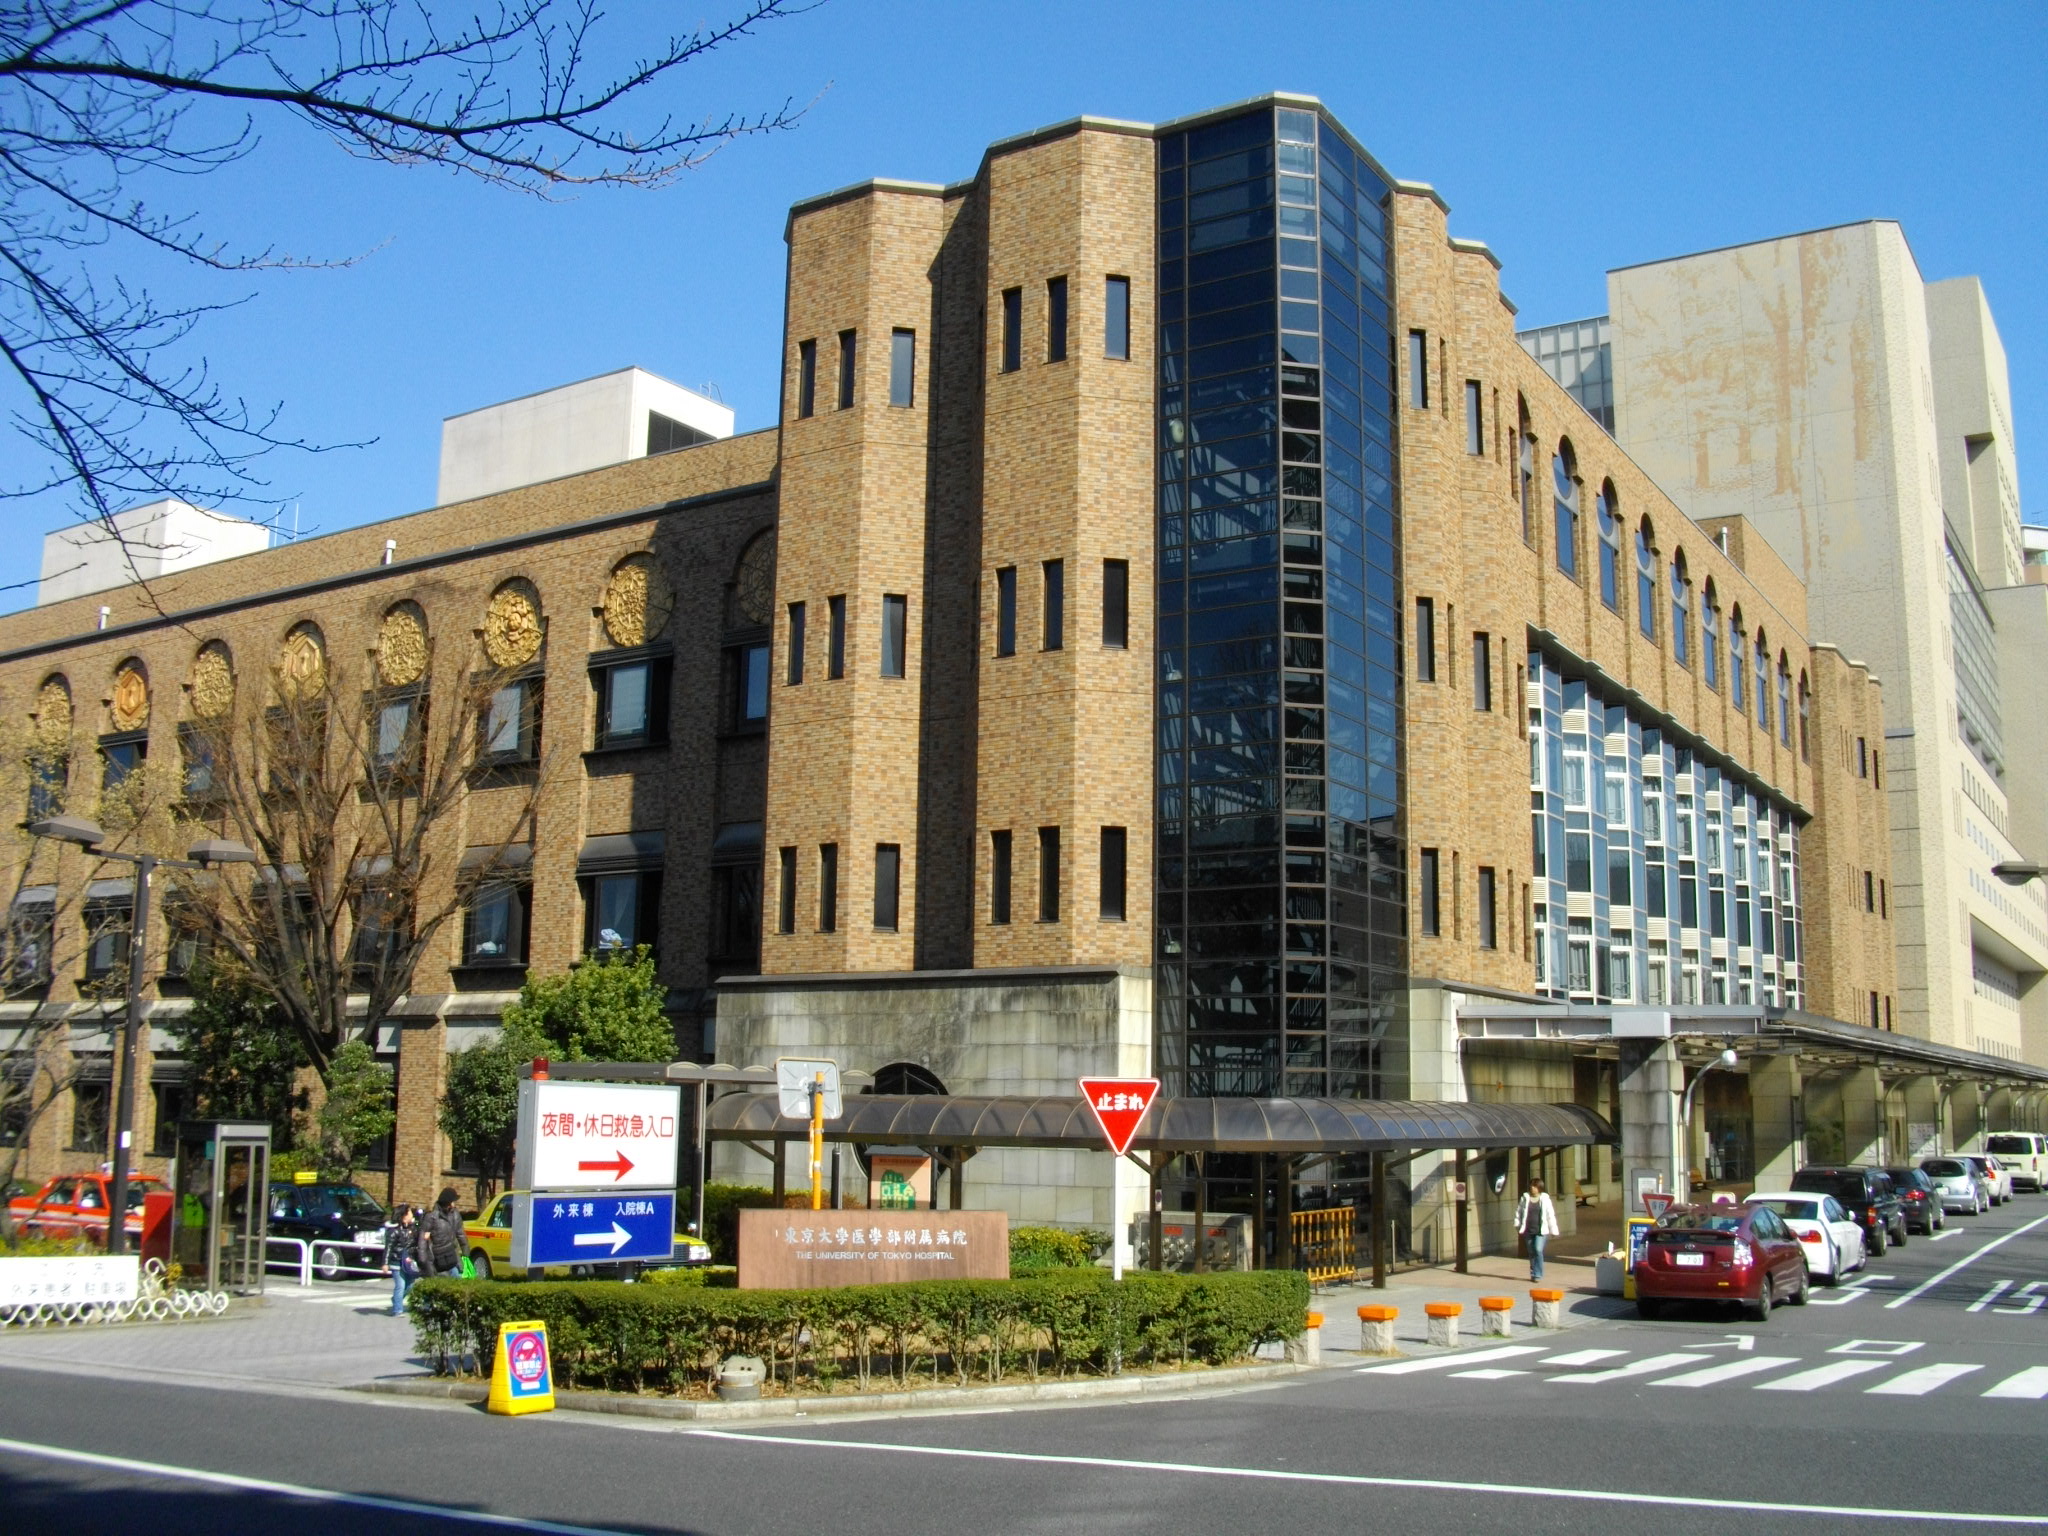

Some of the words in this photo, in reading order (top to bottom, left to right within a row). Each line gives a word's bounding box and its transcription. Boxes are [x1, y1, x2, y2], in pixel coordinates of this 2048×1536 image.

[1097, 1092, 1145, 1110] 止まれ
[542, 1113, 673, 1138] 夜間・休日救急入口
[553, 1203, 593, 1217] 外来棟
[616, 1202, 653, 1215] 入院棟A
[796, 1251, 812, 1259] THE
[815, 1251, 865, 1259] UNIVERSITY
[867, 1251, 880, 1259] OF
[883, 1251, 912, 1259] TOKYO
[914, 1251, 954, 1260] HOSPITAL
